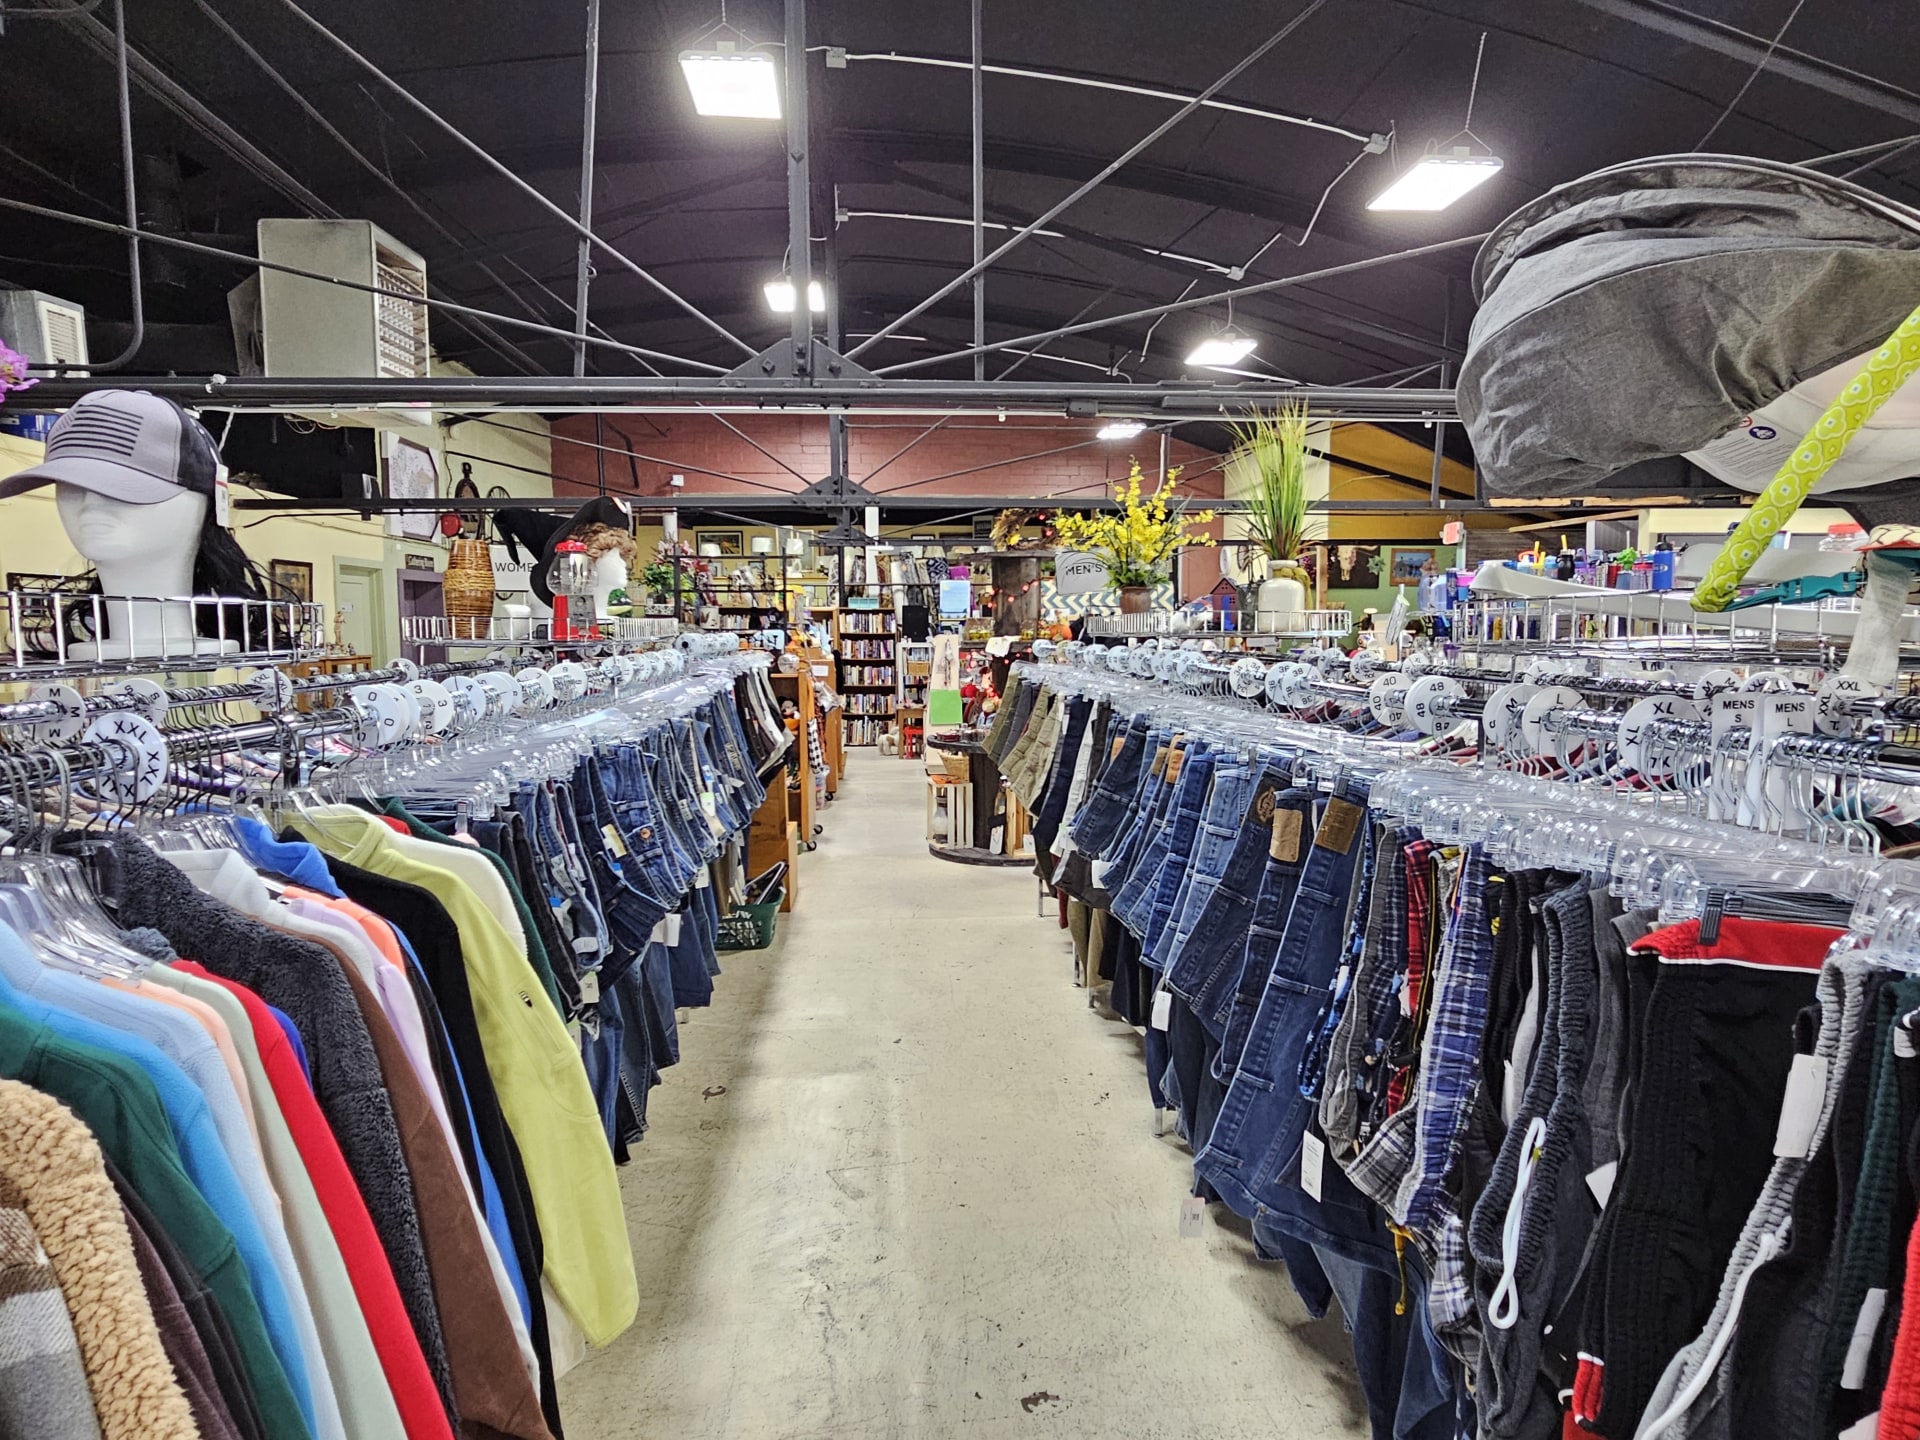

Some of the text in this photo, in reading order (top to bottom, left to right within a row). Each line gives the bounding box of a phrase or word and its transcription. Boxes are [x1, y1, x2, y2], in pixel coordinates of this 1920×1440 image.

[1065, 563, 1103, 576] MEN'S
[1291, 667, 1304, 678] 38
[1382, 676, 1397, 687] 40
[1429, 681, 1445, 692] 48
[1835, 680, 1862, 692] XXL
[49, 688, 61, 697] M
[124, 684, 135, 695] S
[414, 684, 423, 694] 3
[367, 691, 378, 702] 0
[1301, 695, 1313, 705] 38
[1556, 693, 1564, 705] L
[437, 699, 448, 708] 3
[1372, 695, 1381, 711] 40
[1505, 697, 1518, 714] M
[1653, 702, 1675, 715] XL
[1722, 700, 1755, 710] MENS
[1775, 702, 1806, 713] MENS
[1817, 693, 1833, 717] XXL
[70, 706, 81, 718] M
[1415, 702, 1426, 718] 48
[1529, 716, 1542, 724] L
[1734, 713, 1743, 723] S
[1787, 717, 1794, 727] L
[113, 720, 147, 744] XXL
[1435, 722, 1450, 732] 48
[49, 728, 61, 738] M
[1625, 725, 1640, 747] XL
[139, 751, 161, 786] XXL
